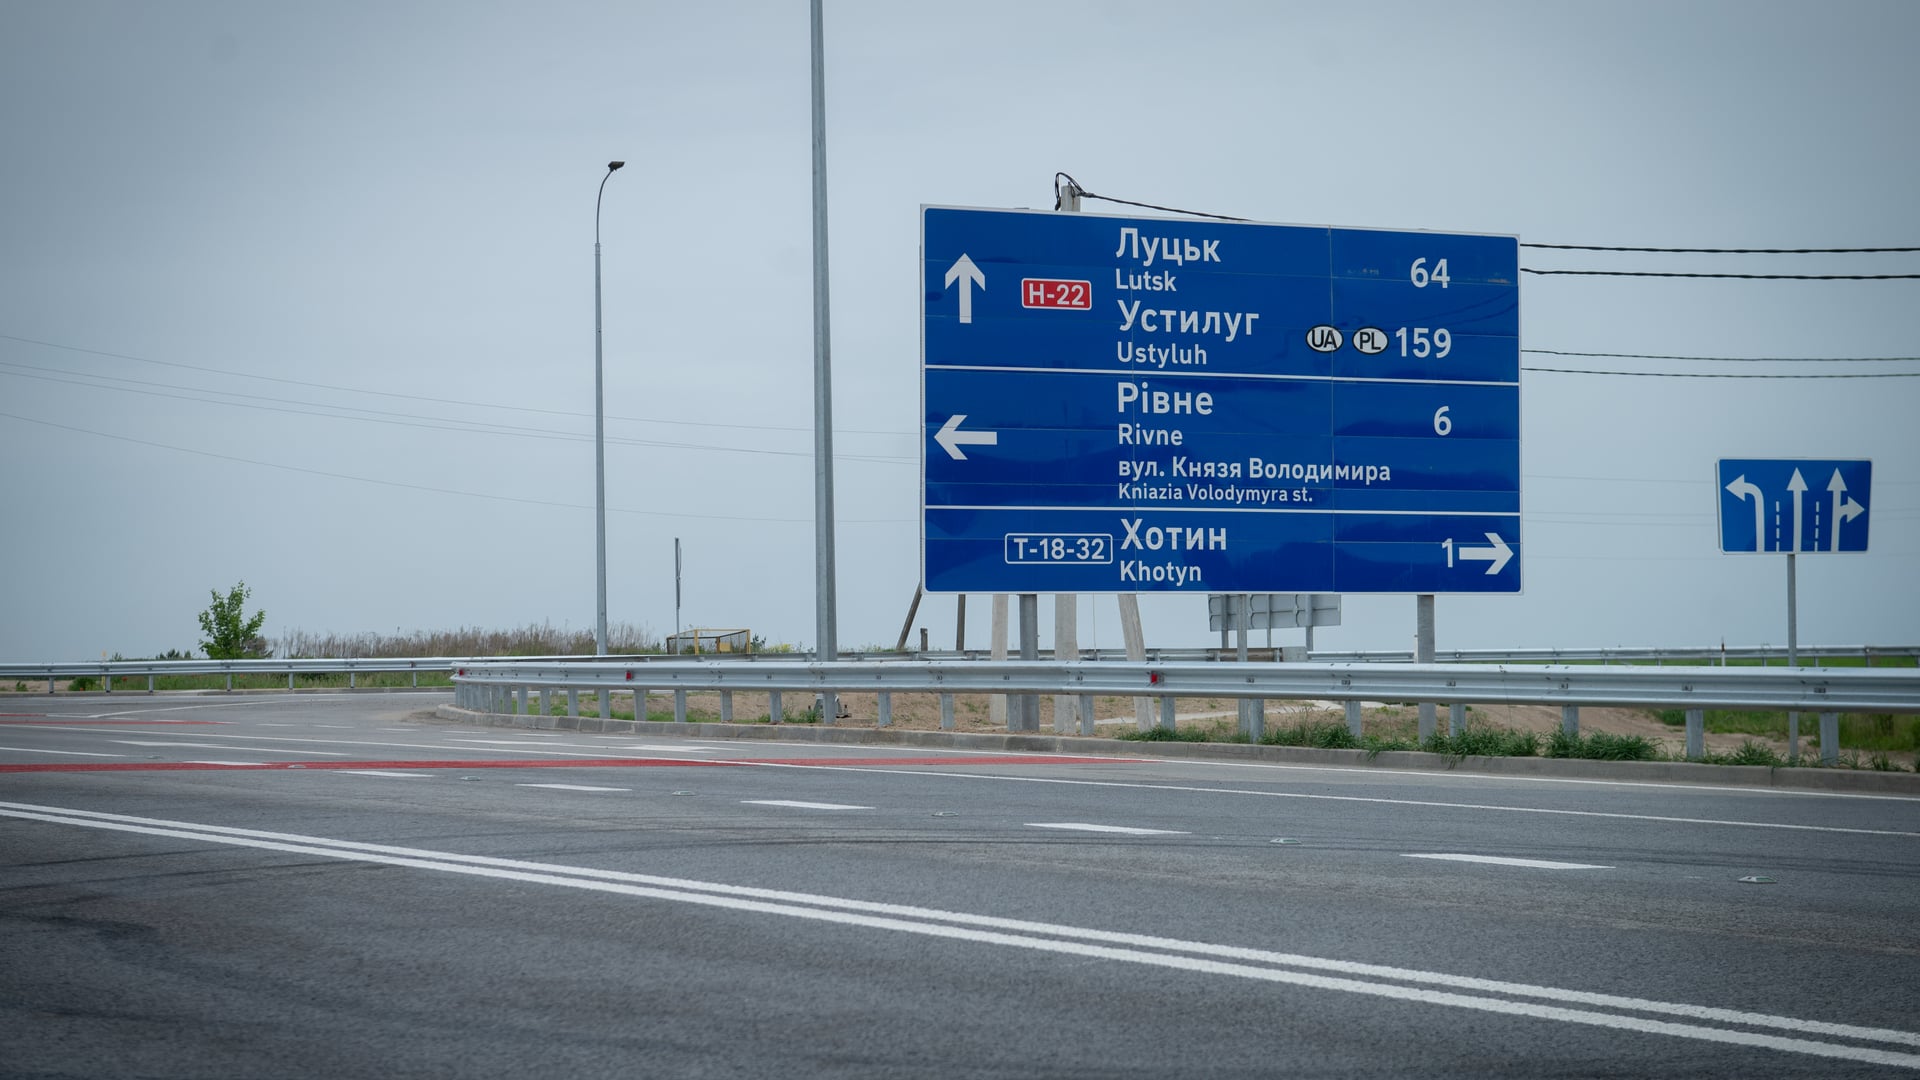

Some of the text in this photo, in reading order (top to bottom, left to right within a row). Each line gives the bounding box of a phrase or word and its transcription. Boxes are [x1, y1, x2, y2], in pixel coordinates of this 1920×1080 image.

[1115, 227, 1221, 267] Луцьк
[1115, 268, 1177, 292] Lutsk
[1410, 257, 1451, 289] 64
[1117, 299, 1259, 342] Устилуг
[1311, 329, 1337, 349] UA
[1359, 332, 1381, 350] PL
[1396, 327, 1452, 359] 159
[1117, 341, 1207, 369] Ustyluh
[1117, 381, 1213, 415] Рівне
[1118, 423, 1183, 446] Rivne
[1433, 406, 1452, 436] 6
[1118, 456, 1391, 485] вул. Князя Володимира
[1118, 483, 1313, 505] Kniazia Volodymyra st.
[1120, 518, 1227, 550] Хотин
[1441, 538, 1453, 568] 1
[1120, 560, 1202, 587] Khotyn
